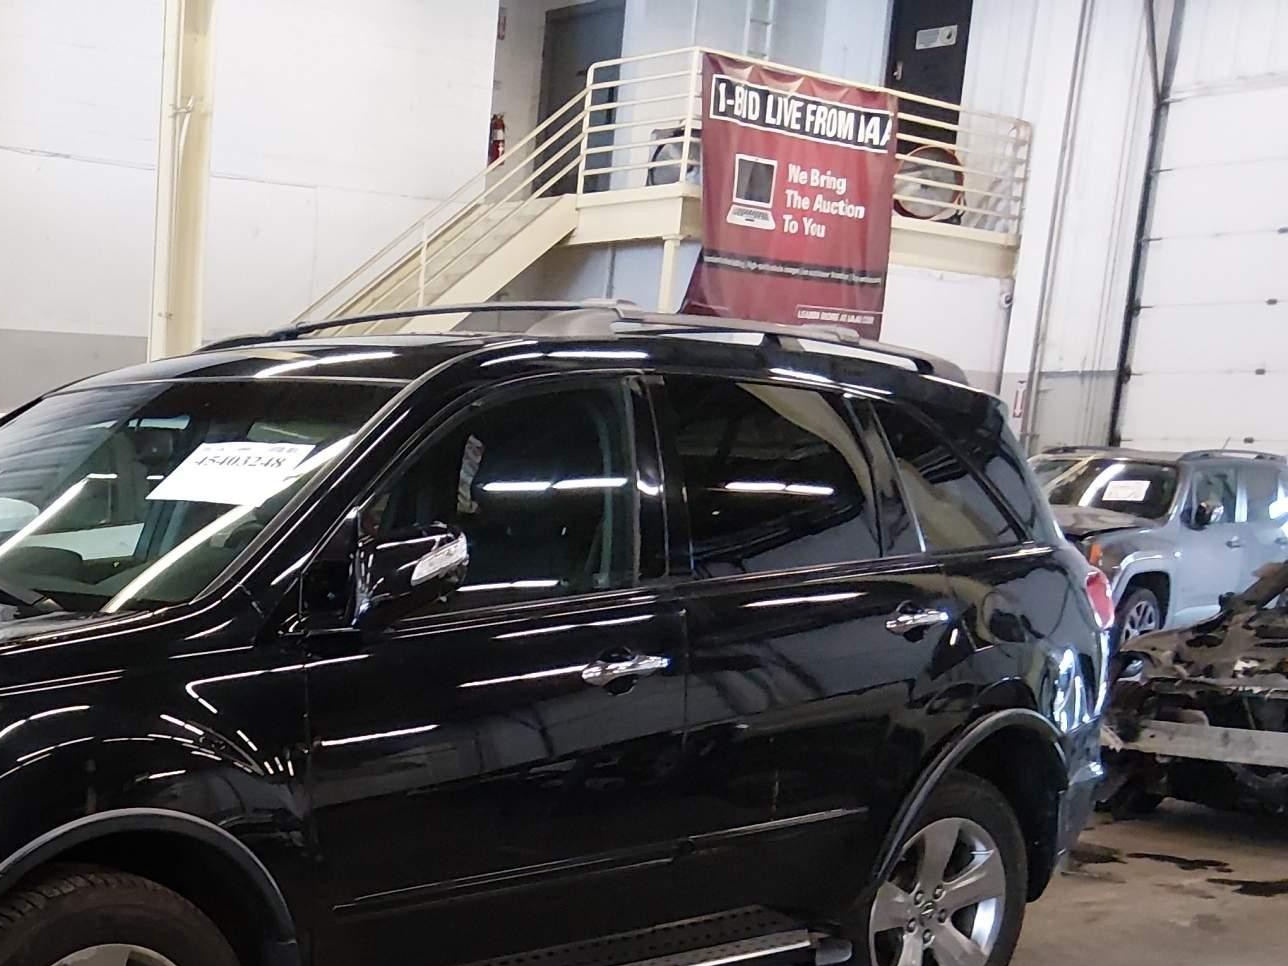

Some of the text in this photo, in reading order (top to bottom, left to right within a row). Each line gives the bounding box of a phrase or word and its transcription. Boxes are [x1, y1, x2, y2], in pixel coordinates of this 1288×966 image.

[765, 94, 803, 129] LIVE
[805, 104, 855, 141] FROM
[787, 163, 847, 195] We Bring
[785, 189, 865, 219] The Auction
[782, 214, 826, 238] To You
[194, 455, 287, 468] 45403248
